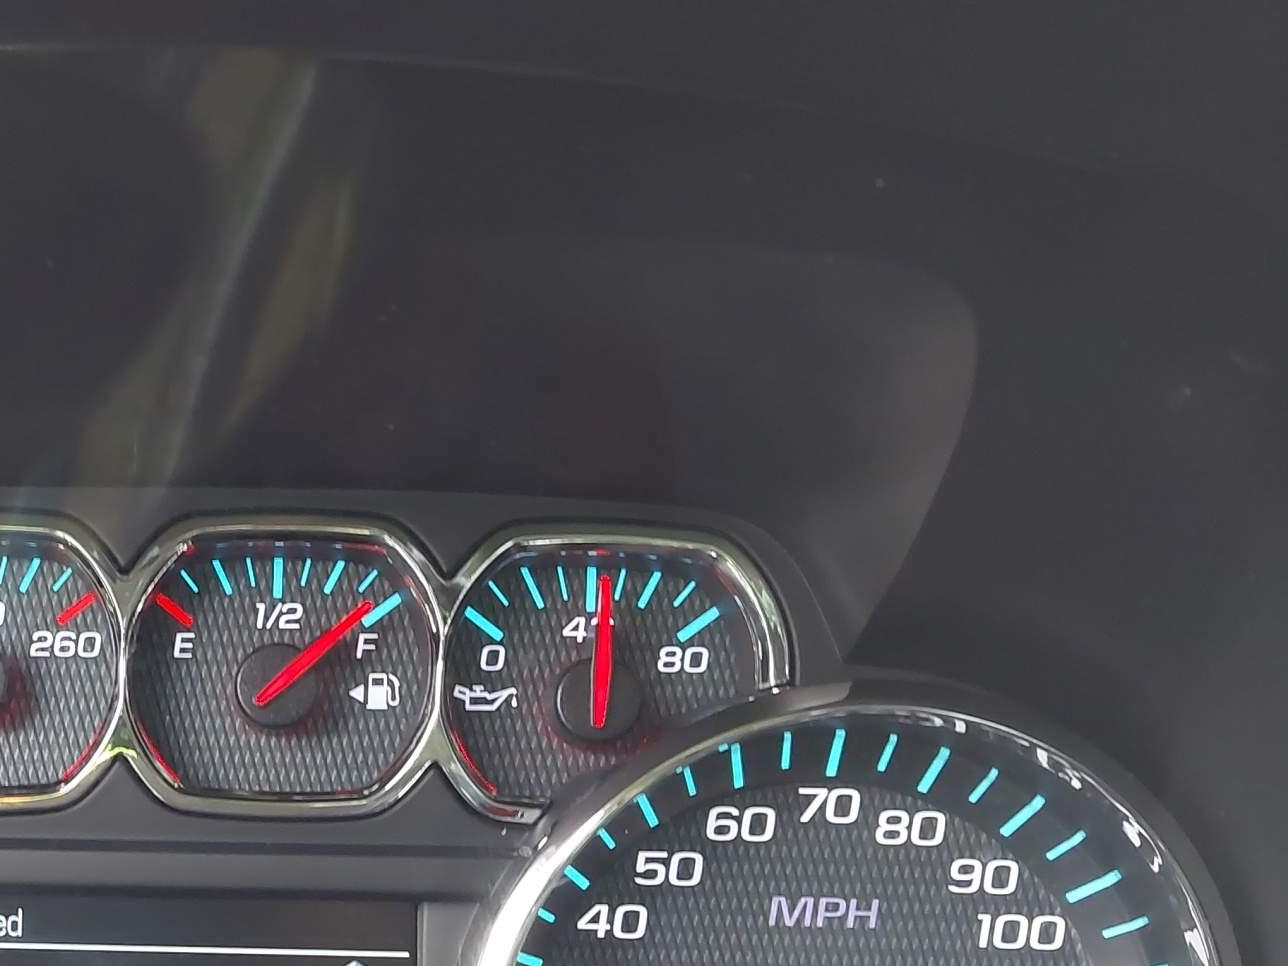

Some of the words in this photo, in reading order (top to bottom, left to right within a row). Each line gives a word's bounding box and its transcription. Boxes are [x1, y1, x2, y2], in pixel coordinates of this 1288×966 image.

[255, 602, 303, 630] 1/2
[562, 616, 615, 644] 4
[29, 630, 102, 659] 260
[173, 632, 196, 660] E
[355, 633, 379, 660] F
[479, 645, 506, 671] 0
[657, 646, 710, 674] 80
[798, 787, 861, 825] 70
[706, 806, 777, 843] 60
[875, 809, 947, 847] 80
[633, 851, 704, 888] 50
[948, 858, 1020, 896] 90
[576, 904, 649, 941] 40
[768, 896, 880, 930] MPH
[977, 912, 1067, 952] 100
